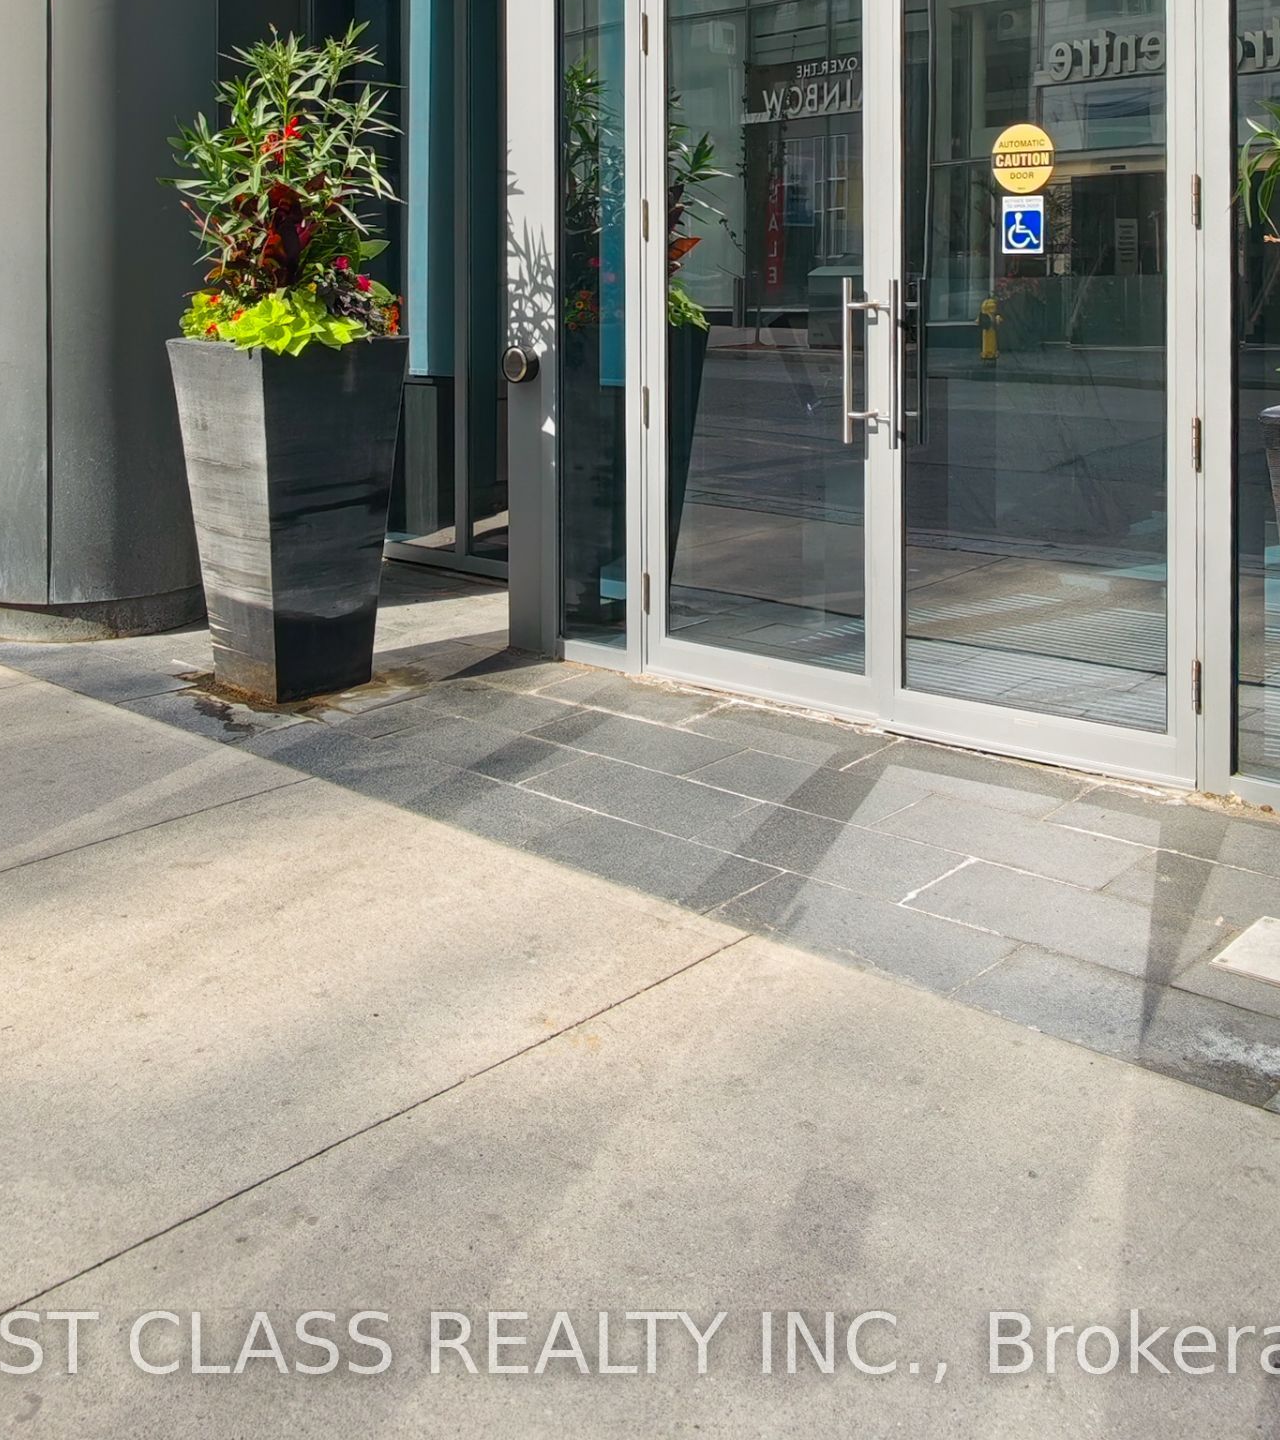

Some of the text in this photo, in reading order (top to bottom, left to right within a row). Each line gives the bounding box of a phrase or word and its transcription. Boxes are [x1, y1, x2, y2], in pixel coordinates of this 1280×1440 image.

[998, 139, 1045, 148] AUTOMATIC
[995, 152, 1050, 167] CAUTION
[1009, 171, 1035, 180] DOOR
